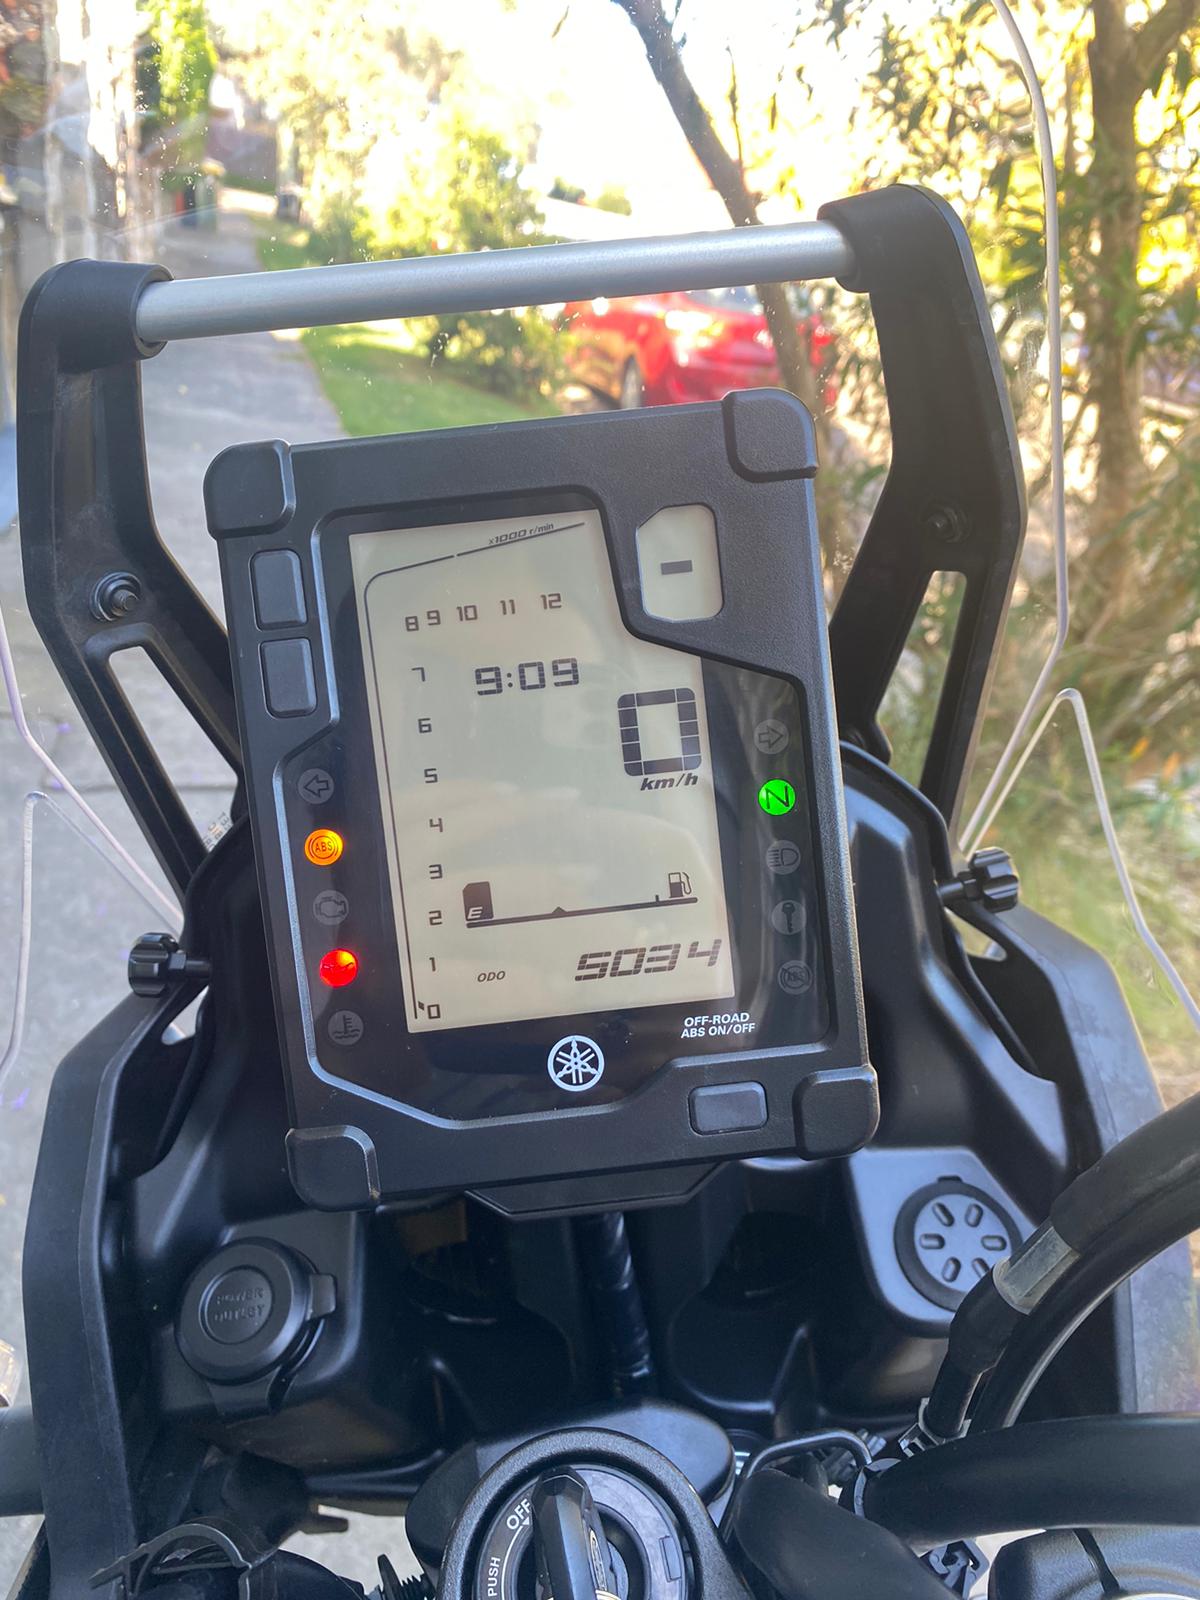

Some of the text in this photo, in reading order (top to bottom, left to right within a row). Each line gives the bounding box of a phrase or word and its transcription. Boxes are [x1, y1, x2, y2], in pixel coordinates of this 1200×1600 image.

[488, 523, 554, 545] x1000 r/min
[405, 592, 562, 632] 8 9 10 11 12
[411, 667, 426, 682] 7
[474, 657, 580, 696] 9:09
[417, 717, 432, 734] 6
[617, 687, 702, 777] 0
[424, 767, 438, 784] 5
[640, 772, 699, 791] km/h
[765, 784, 791, 809] N
[429, 817, 444, 833] 4
[315, 841, 333, 852] ABS
[428, 863, 443, 880] 3
[428, 909, 443, 926] 2
[467, 906, 484, 920] E
[429, 956, 436, 972] 1
[574, 938, 723, 982] 5034
[477, 970, 506, 983] ODO
[427, 1003, 442, 1020] 0
[684, 1012, 750, 1028] OFF-ROAD
[681, 1022, 756, 1039] ABS ON/OFF
[506, 1498, 531, 1530] OFF
[487, 1556, 501, 1597] PUSH
